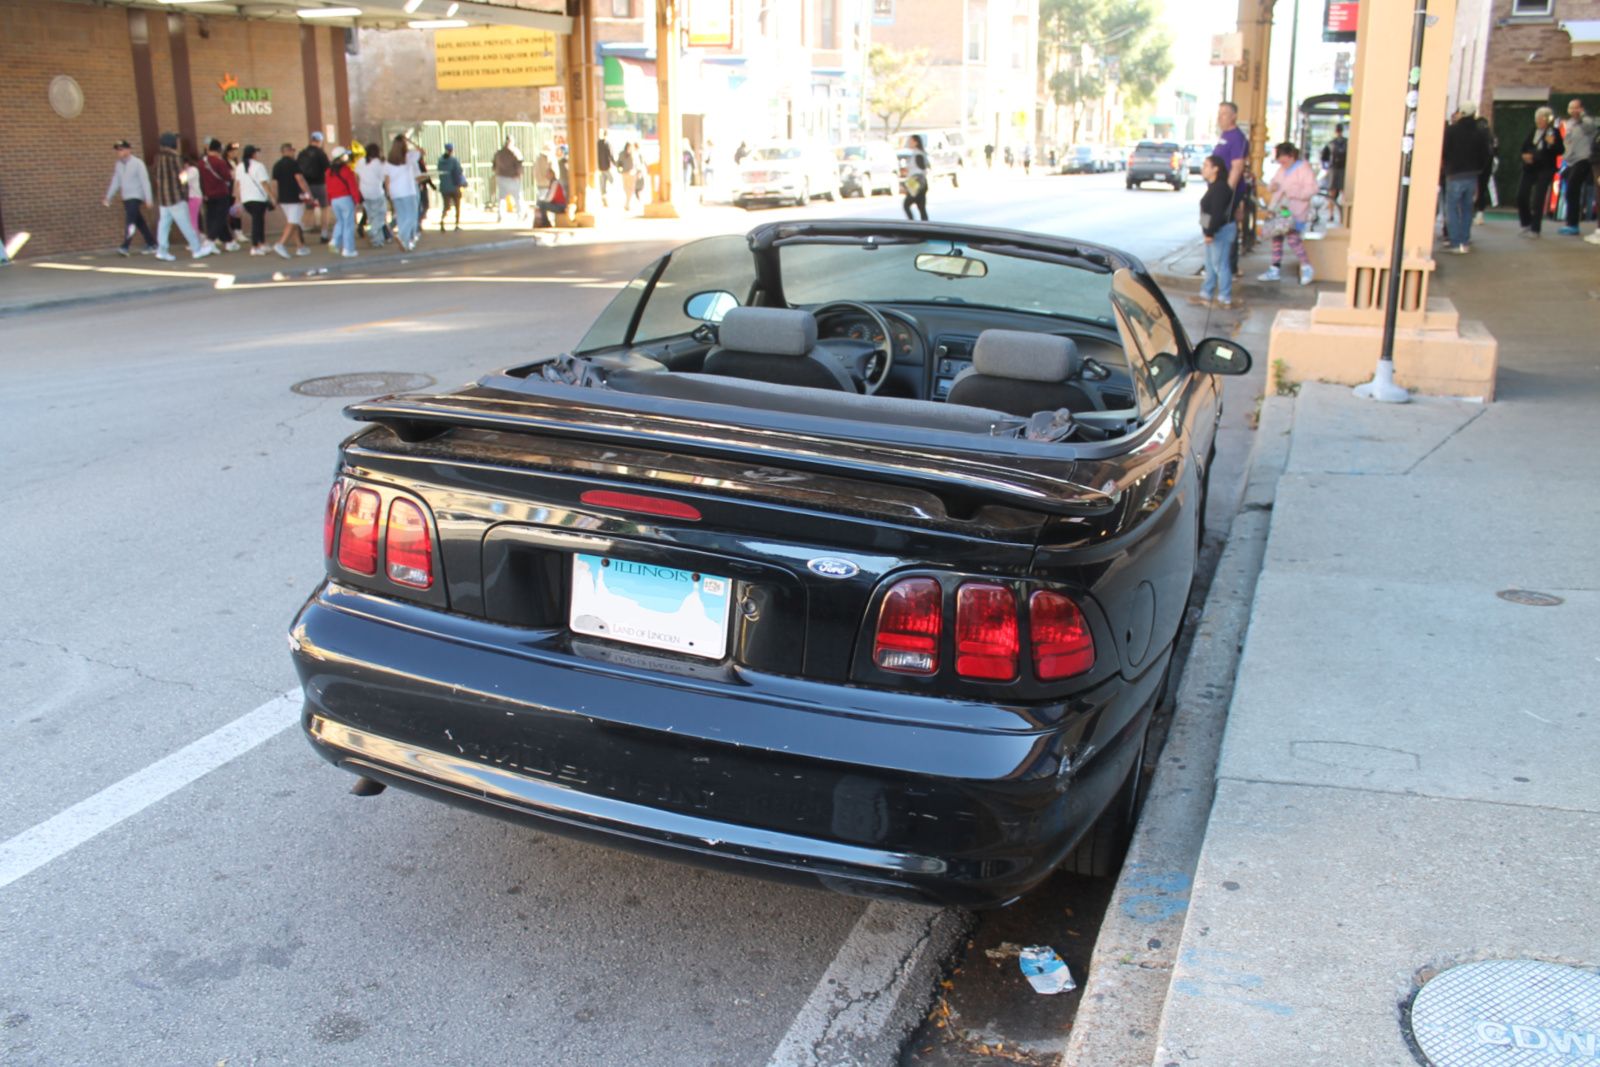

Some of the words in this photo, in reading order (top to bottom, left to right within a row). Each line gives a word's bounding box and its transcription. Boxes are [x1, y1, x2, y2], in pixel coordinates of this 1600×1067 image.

[481, 67, 500, 75] THAN
[230, 100, 273, 115] KINGS
[614, 560, 689, 582] ILLINOIS
[819, 560, 848, 575] Ford
[612, 623, 635, 636] LAND
[635, 629, 646, 637] OF
[647, 630, 681, 645] LINCOLN
